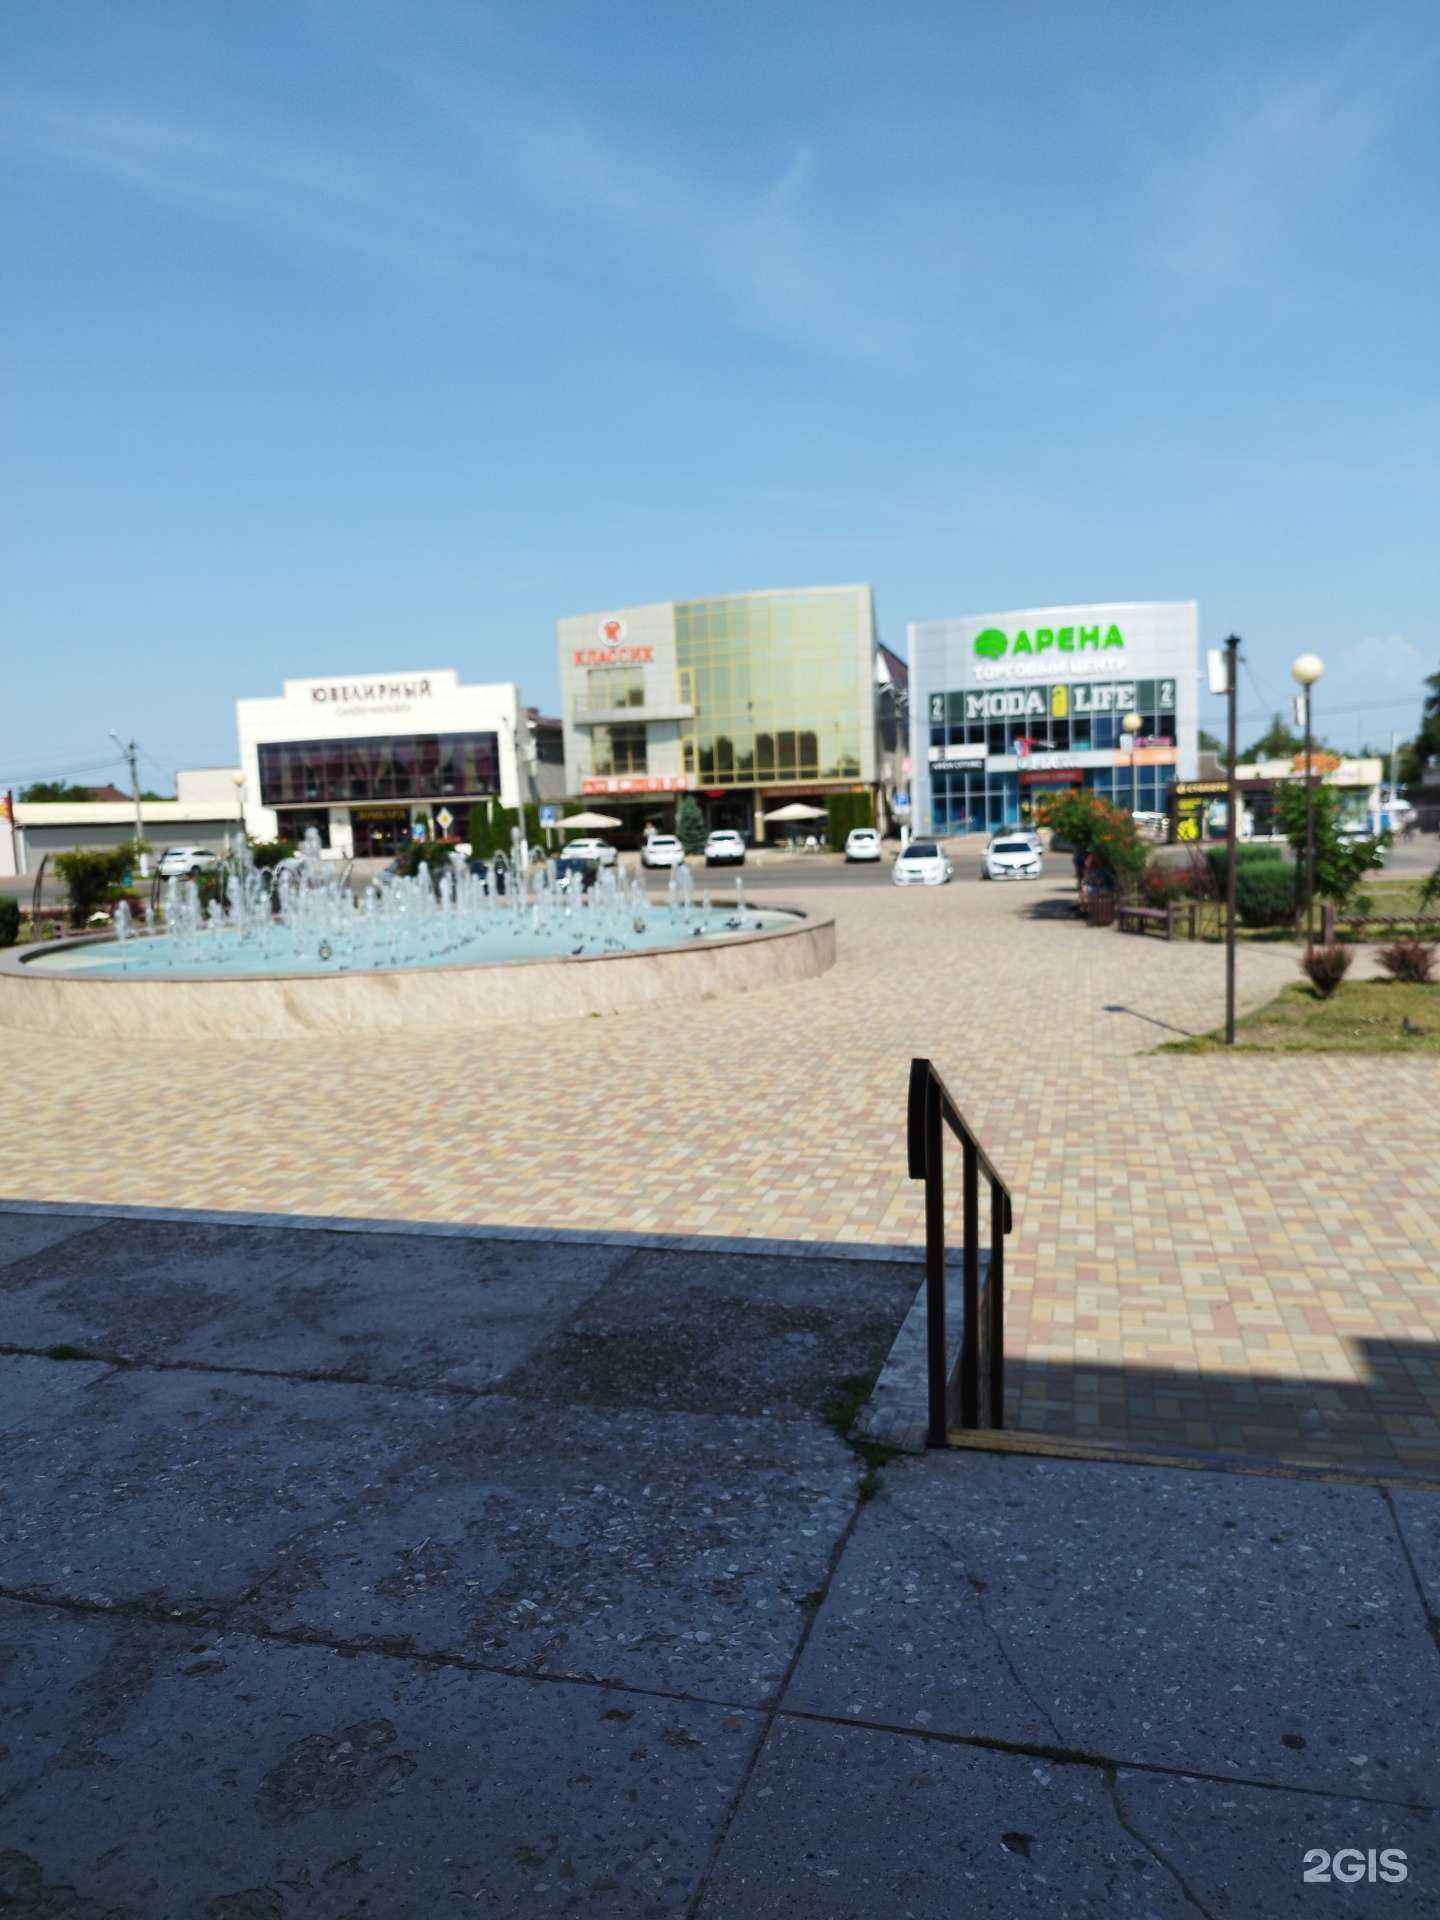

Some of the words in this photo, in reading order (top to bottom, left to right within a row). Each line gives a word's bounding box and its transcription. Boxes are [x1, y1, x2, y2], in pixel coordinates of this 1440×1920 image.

[1012, 623, 1125, 656] АРЕНА
[312, 679, 432, 703] ЮВЕЛИРНЫЙ
[966, 690, 1046, 719] MODA
[1073, 683, 1136, 712] LIFE
